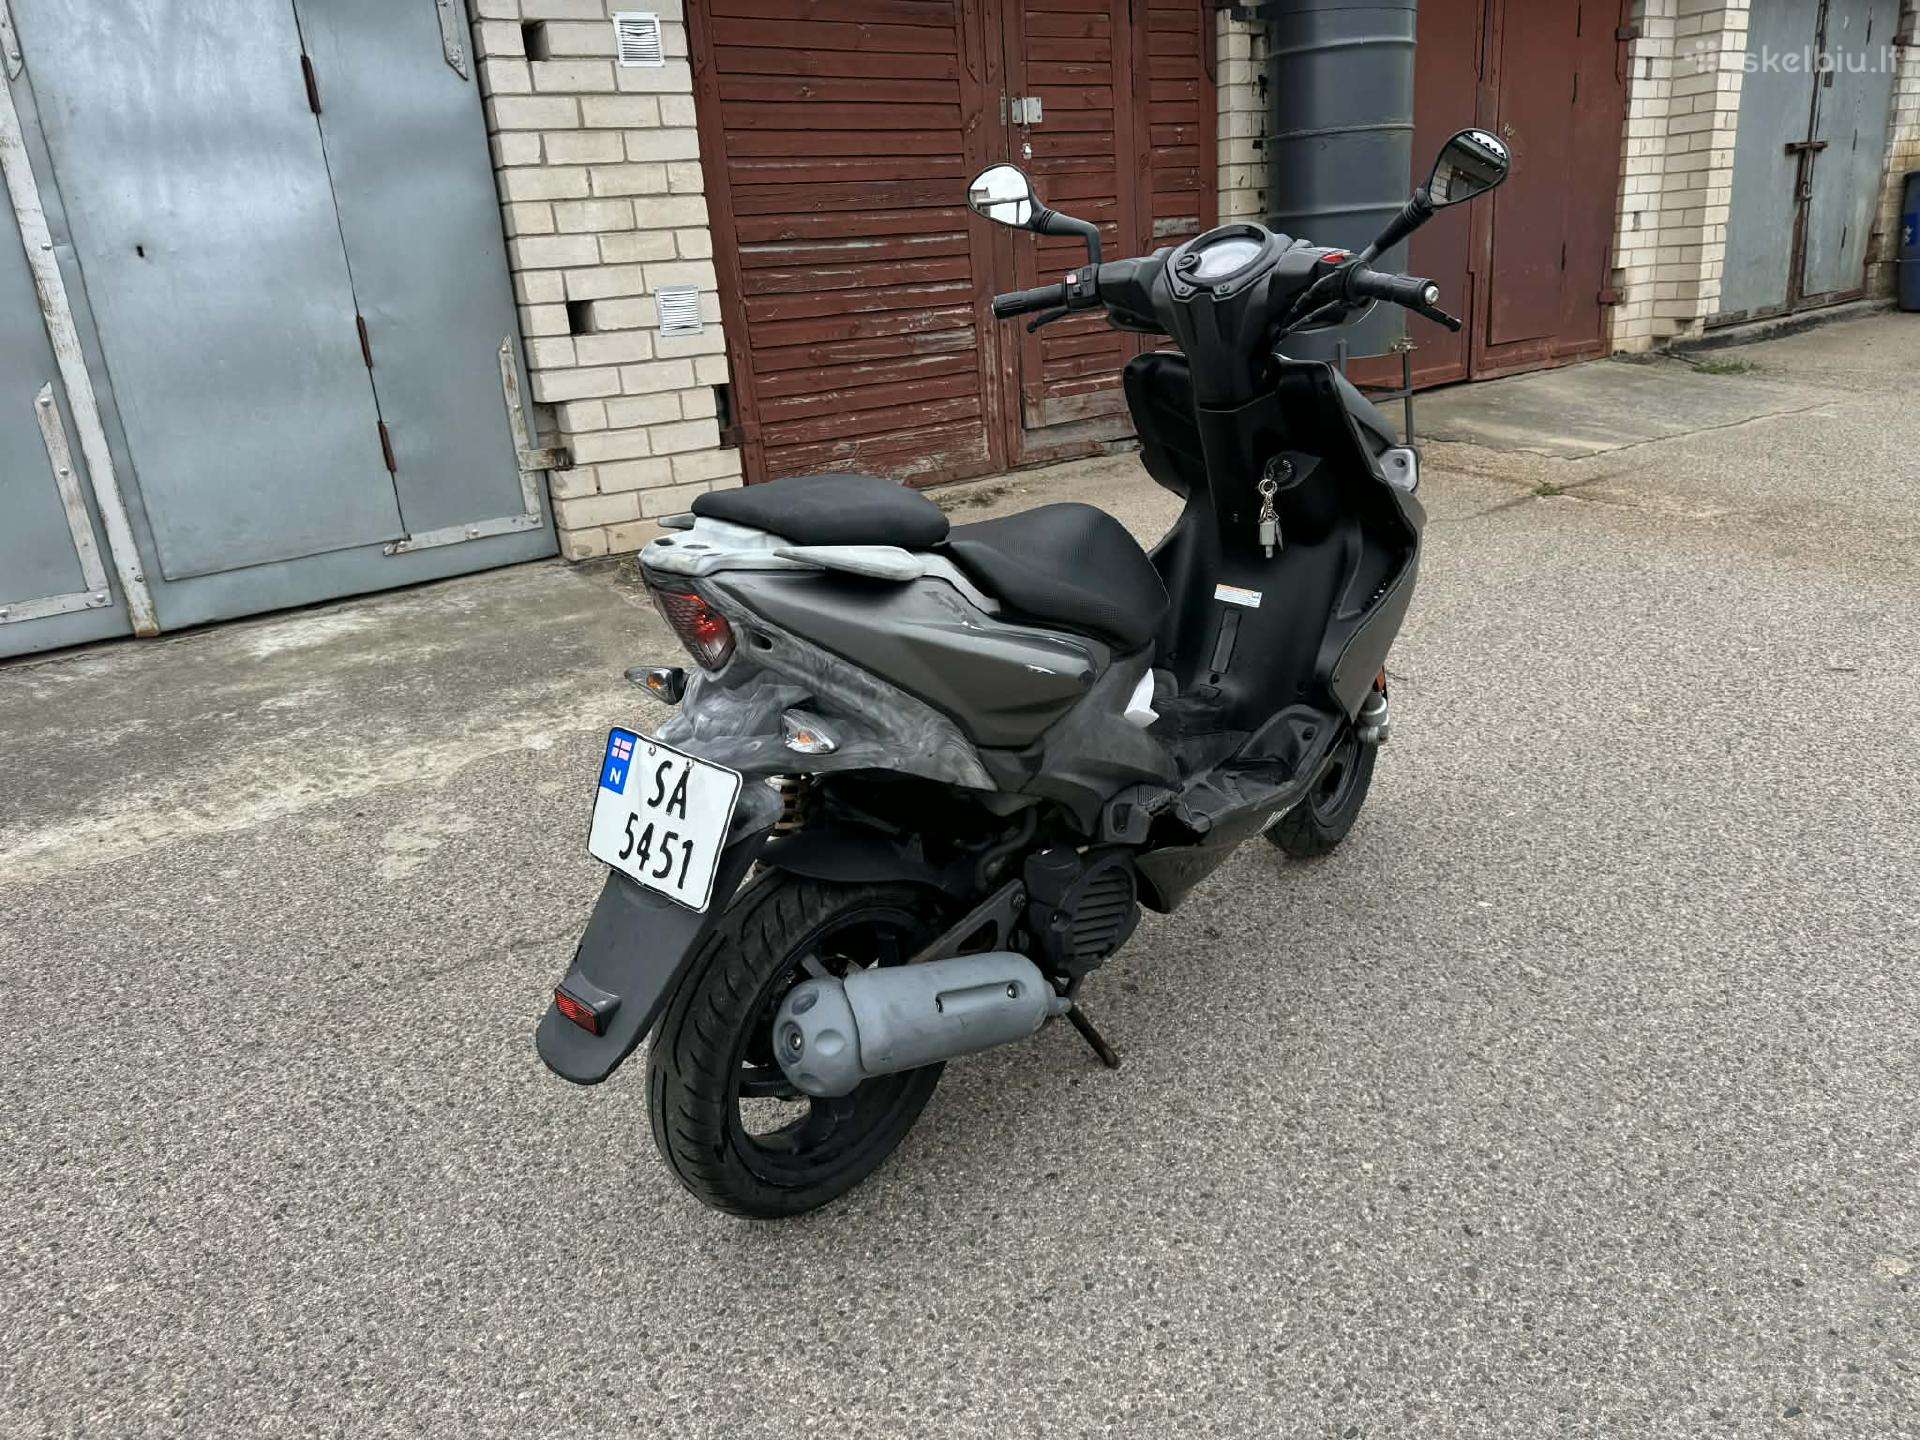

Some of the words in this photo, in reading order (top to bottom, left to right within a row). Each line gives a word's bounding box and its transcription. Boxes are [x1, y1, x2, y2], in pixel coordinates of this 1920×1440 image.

[609, 767, 622, 785] N
[647, 761, 691, 820] SA
[618, 812, 694, 890] 5451
